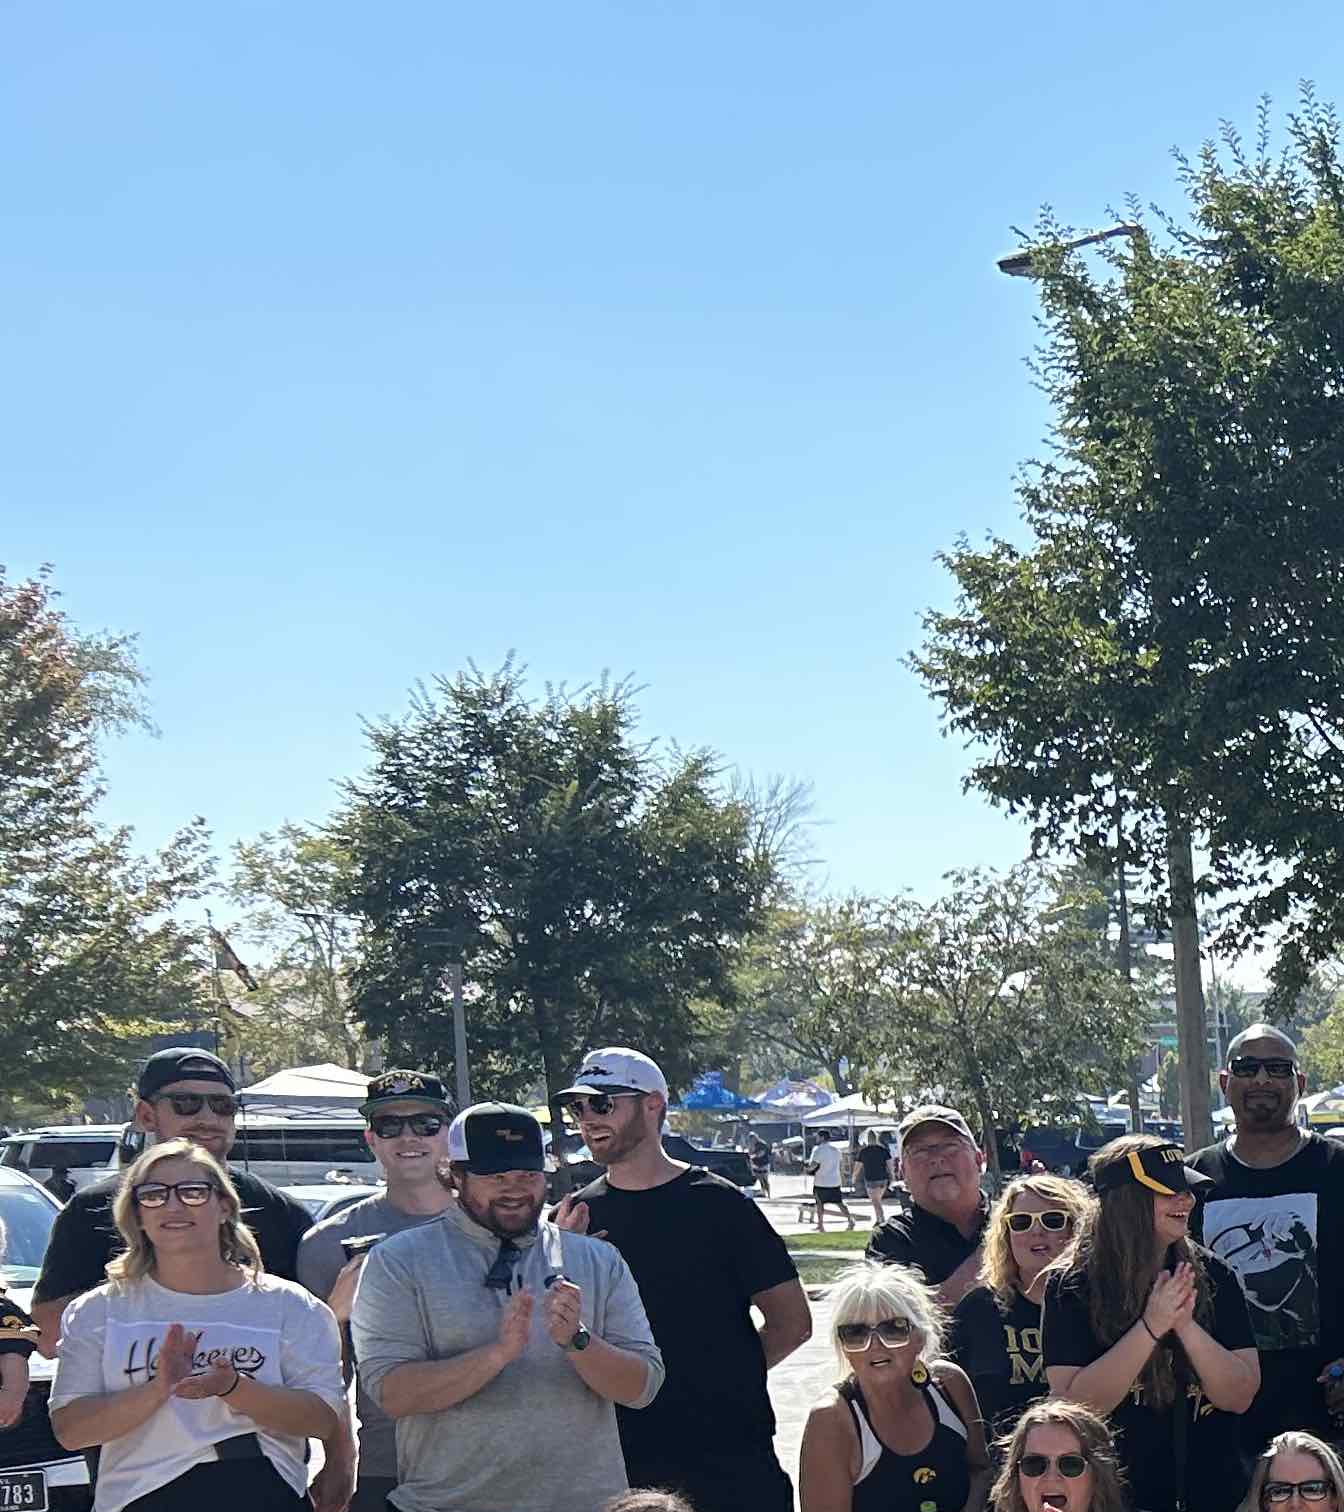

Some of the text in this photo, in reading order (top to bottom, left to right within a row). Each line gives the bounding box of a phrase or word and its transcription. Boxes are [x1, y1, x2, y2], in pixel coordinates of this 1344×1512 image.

[1003, 1324, 1043, 1353] IO
[124, 1331, 266, 1382] Hkeyes
[1009, 1353, 1048, 1385] M
[1, 1483, 34, 1505] 783
